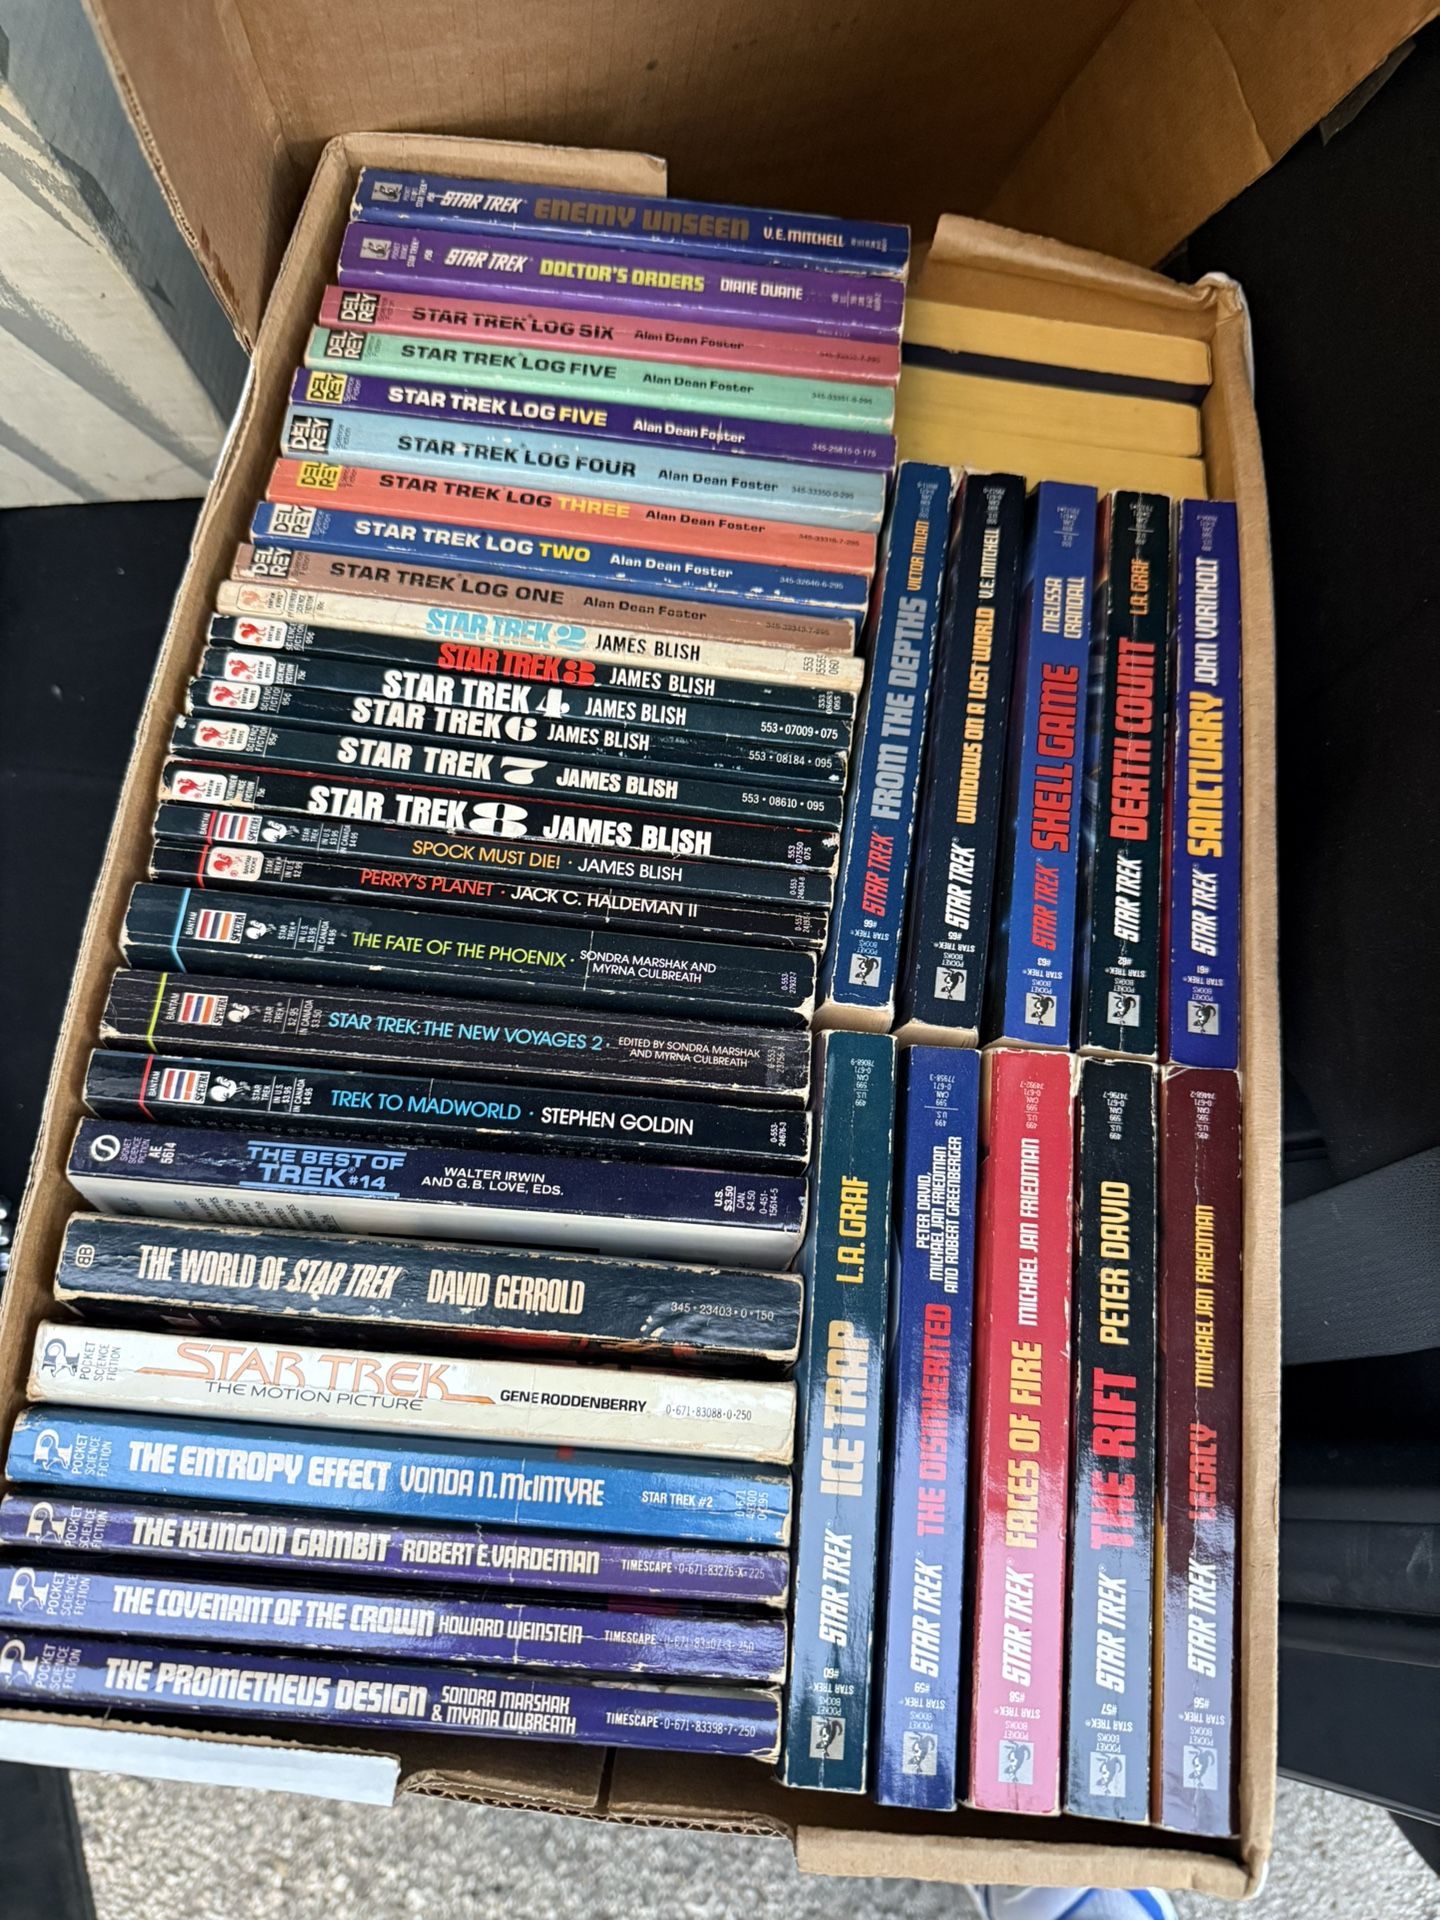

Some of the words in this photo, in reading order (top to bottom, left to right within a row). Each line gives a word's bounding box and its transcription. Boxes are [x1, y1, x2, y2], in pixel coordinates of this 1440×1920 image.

[534, 198, 635, 228] ENEMY
[641, 207, 749, 240] UNSEEN
[538, 258, 627, 284] DOCTOR'S
[631, 269, 704, 292] ORDERS
[720, 276, 758, 295] DIANE
[760, 281, 803, 300] DUANE
[411, 306, 467, 325] STAR
[471, 309, 526, 330] TREK
[530, 317, 574, 336] LOG
[578, 322, 613, 339] SIX
[387, 385, 445, 408] STAR
[449, 392, 505, 415] TREK
[508, 399, 555, 419] LOG
[557, 406, 607, 426] FIVE
[632, 420, 662, 434] Alan
[664, 423, 698, 438] Dean
[699, 426, 745, 443] Foster
[378, 473, 436, 491] STAR
[443, 481, 500, 501] TREK
[505, 488, 552, 506] LOG
[557, 496, 631, 518] THREE
[887, 596, 928, 688] DEPTHS
[971, 606, 995, 664] WORLD
[437, 642, 501, 673] STAR
[501, 648, 560, 683] TREK
[563, 658, 596, 686] 3
[967, 658, 990, 700] LOST
[1114, 636, 1155, 735] COUNT
[351, 696, 426, 730] STAR
[433, 705, 502, 739] TREK
[504, 716, 538, 741] 6
[382, 668, 455, 706] STAR
[460, 679, 531, 713] TREK
[536, 687, 570, 718] 4
[585, 696, 635, 720] JAMES
[640, 703, 687, 725] BLISH
[880, 691, 916, 738] THE
[966, 701, 987, 713] A
[1035, 662, 1079, 759] GAME
[963, 714, 985, 740] ON
[870, 742, 909, 820] FROM
[956, 740, 983, 825] WINDOWS
[1109, 736, 1152, 842] DEATH
[1186, 690, 1224, 859] SANCTUARY
[307, 783, 384, 822] STAR
[394, 794, 469, 830] TREK
[468, 801, 529, 838] 8
[1030, 763, 1074, 853] SHELL
[360, 867, 428, 889] PERRY'S
[430, 875, 494, 896] PLANET
[411, 839, 474, 861] SPOCK
[478, 846, 525, 866] MUST
[528, 851, 560, 868] DIE!
[577, 857, 634, 877] JAMES
[638, 861, 683, 881] BLISH
[352, 931, 383, 949] THE
[383, 933, 423, 952] FATE
[426, 937, 452, 954] OF
[456, 941, 484, 959] THE
[488, 945, 566, 967] PHOENIX
[579, 949, 629, 964] SONDRA
[631, 954, 687, 970] MARSHAK
[690, 961, 716, 973] AND
[592, 962, 636, 977] MYRNA
[637, 967, 702, 983] CULBREATH
[327, 1012, 372, 1030] STAR
[424, 1020, 453, 1038] THE
[458, 1023, 500, 1041] NEW
[503, 1026, 587, 1049] VOYAGES
[591, 1035, 603, 1050] 2
[330, 1089, 372, 1108] TREK
[377, 1093, 403, 1111] TO
[406, 1096, 521, 1120] MADWORLD
[540, 1106, 615, 1129] STEPHEN
[619, 1113, 693, 1136] GOLDIN
[148, 1145, 162, 1159] AE
[160, 1142, 176, 1164] 5614
[246, 1145, 300, 1164] THE
[300, 1149, 367, 1168] BEST
[370, 1154, 406, 1170] OF
[257, 1161, 345, 1187] TREK
[348, 1173, 386, 1190] #14
[443, 1166, 502, 1179] WALTER
[504, 1170, 545, 1183] IRWIN
[420, 1175, 453, 1187] AND
[489, 1180, 528, 1194] LOVE,
[532, 1182, 563, 1196] EDS.
[838, 1175, 869, 1238] GRAF
[1099, 1179, 1131, 1260] DAVID
[136, 1244, 178, 1281] THE
[178, 1248, 257, 1289] WORLD
[257, 1255, 289, 1290] OF
[285, 1257, 348, 1297] STAR
[344, 1262, 404, 1300] TREK
[426, 1268, 491, 1307] DAVID
[493, 1273, 586, 1314] GERROLD
[1098, 1265, 1130, 1345] PETER
[78, 1341, 97, 1380] POCKET
[93, 1342, 110, 1381] SCIENCE
[106, 1344, 121, 1380] FICTION
[135, 1341, 305, 1388] STAR
[318, 1353, 495, 1405] TREK
[823, 1319, 870, 1430] TRAP
[1009, 1339, 1043, 1407] FIRE
[204, 1380, 245, 1395] THE
[250, 1384, 332, 1403] MOTION
[335, 1391, 423, 1411] PICTURE
[499, 1388, 539, 1404] GENE
[540, 1391, 648, 1413] RODDENBERRY
[918, 1302, 952, 1481] DISINHERITED
[1092, 1366, 1137, 1458] RIFT
[1008, 1412, 1041, 1453] OF
[128, 1440, 178, 1475] THE
[178, 1444, 304, 1484] ENTROPY
[306, 1454, 393, 1492] EFFECT
[819, 1436, 865, 1496] ICE
[1188, 1421, 1217, 1520] LEGACY
[916, 1486, 947, 1536] THE
[1005, 1457, 1040, 1549] FACES
[1089, 1469, 1136, 1550] THE
[131, 1516, 178, 1548] THE
[178, 1519, 288, 1556] KLINGON
[290, 1526, 392, 1561] GAMBIT
[112, 1584, 156, 1616] THE
[156, 1590, 274, 1624] COVENANT
[273, 1597, 302, 1628] OF
[305, 1599, 348, 1631] THE
[349, 1604, 436, 1637] CROWN
[104, 1657, 154, 1693] THE
[155, 1661, 332, 1708] PROMETHEUS
[334, 1677, 429, 1718] DESIGN
[1101, 1704, 1117, 1715] #57
[1097, 1732, 1119, 1742] BOOKS
